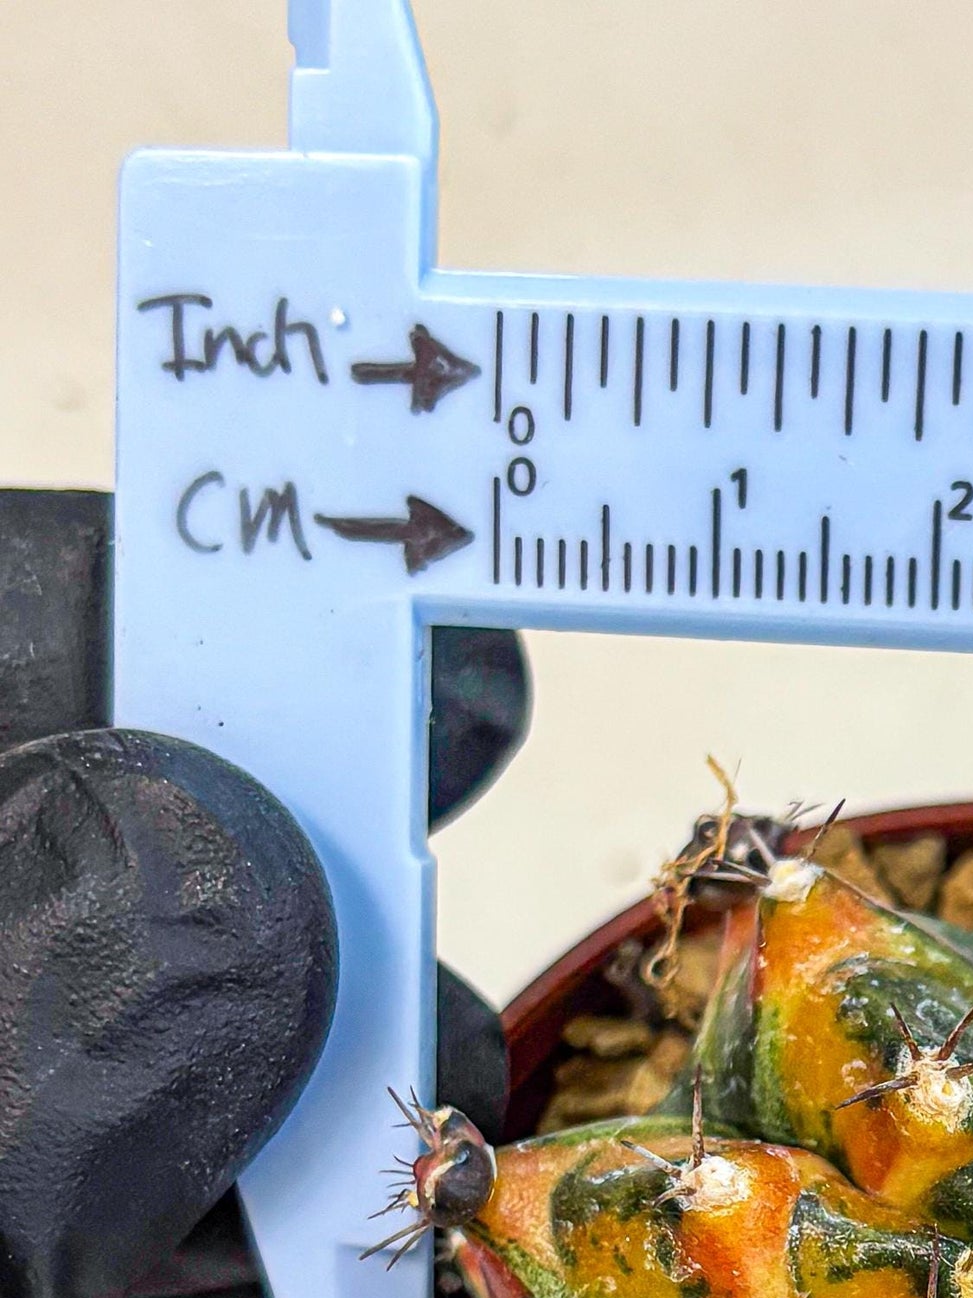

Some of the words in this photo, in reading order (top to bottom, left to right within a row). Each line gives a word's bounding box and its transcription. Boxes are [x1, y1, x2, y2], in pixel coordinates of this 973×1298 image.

[137, 293, 329, 385] Inch
[507, 405, 536, 446] 0
[506, 456, 537, 497] 0
[730, 467, 748, 510] 1
